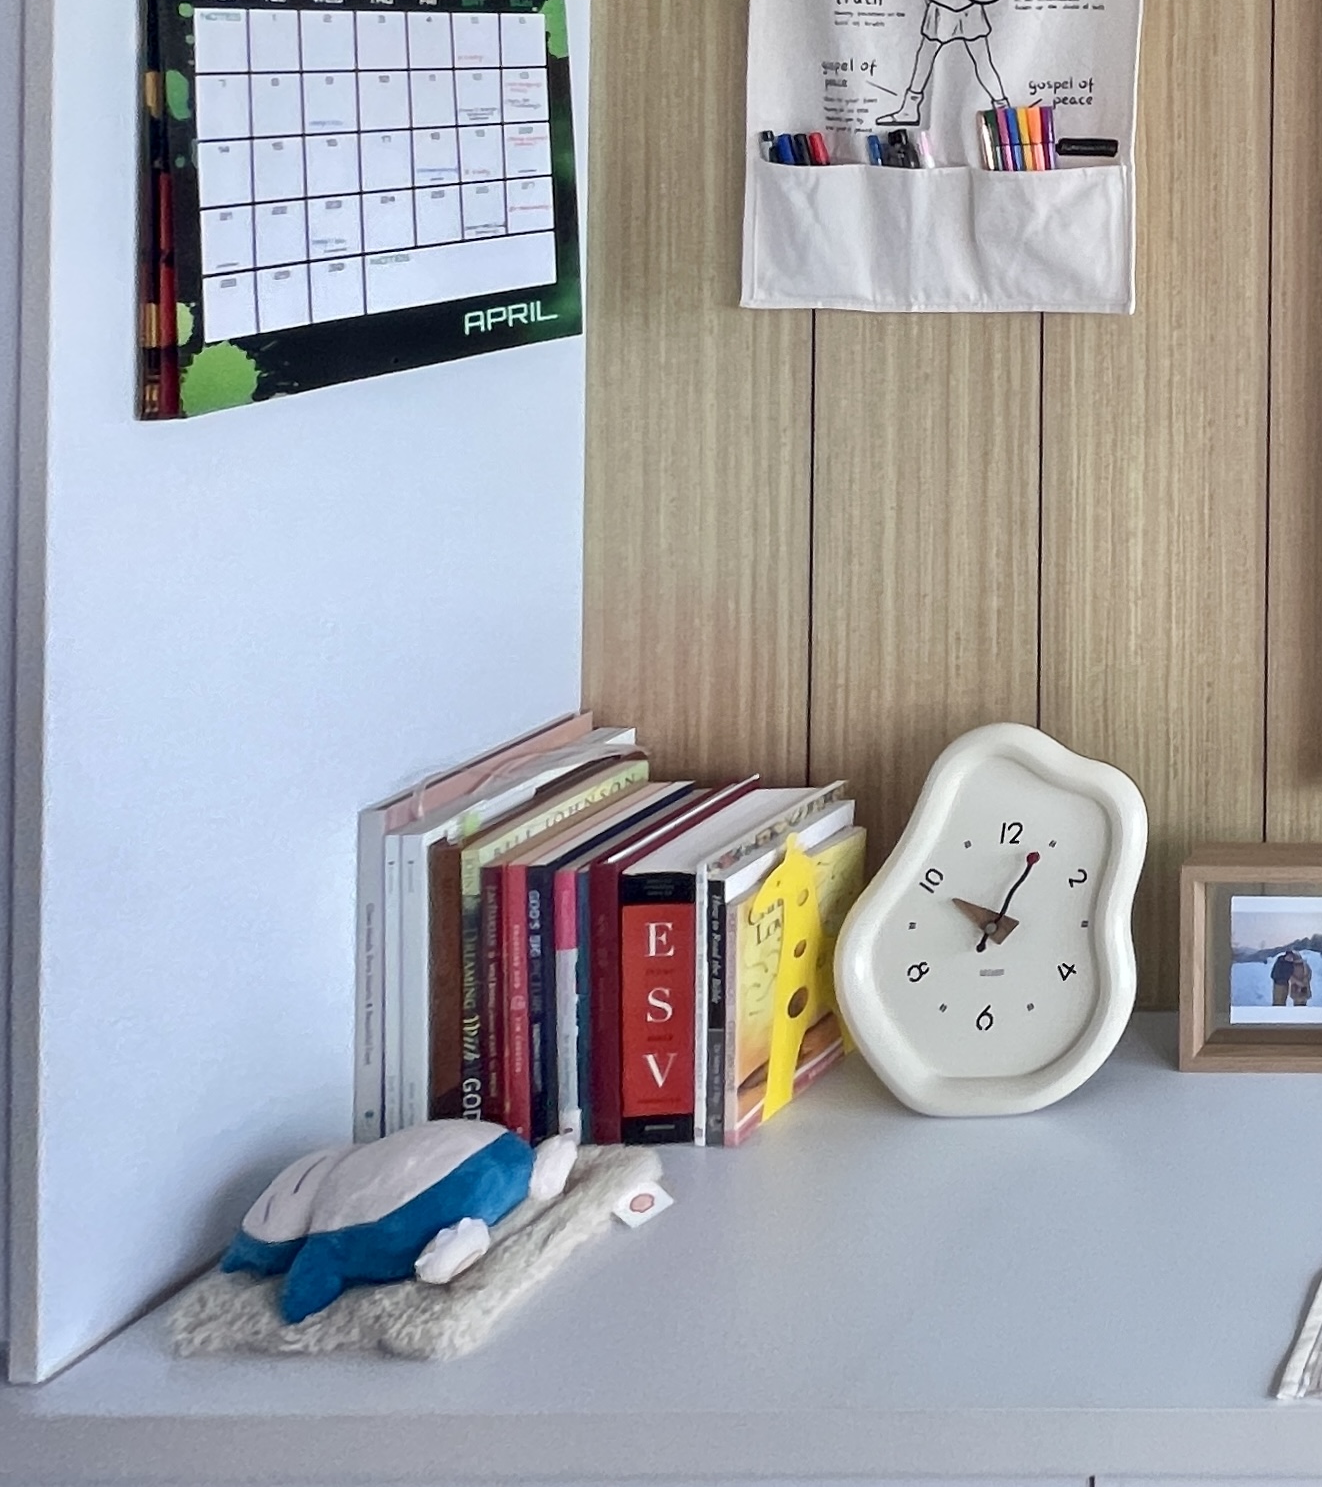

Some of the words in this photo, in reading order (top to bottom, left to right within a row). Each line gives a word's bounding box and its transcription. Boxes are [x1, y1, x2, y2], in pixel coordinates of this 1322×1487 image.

[860, 59, 877, 76] of
[1028, 77, 1073, 95] gospel
[1078, 77, 1094, 93] of
[1052, 96, 1093, 110] peace
[464, 300, 559, 336] APRIL
[999, 821, 1024, 845] 12
[918, 867, 945, 894] 10
[1068, 867, 1089, 889] 2
[906, 960, 931, 984] 8
[1056, 961, 1078, 982] 4
[975, 1004, 995, 1032] 6
